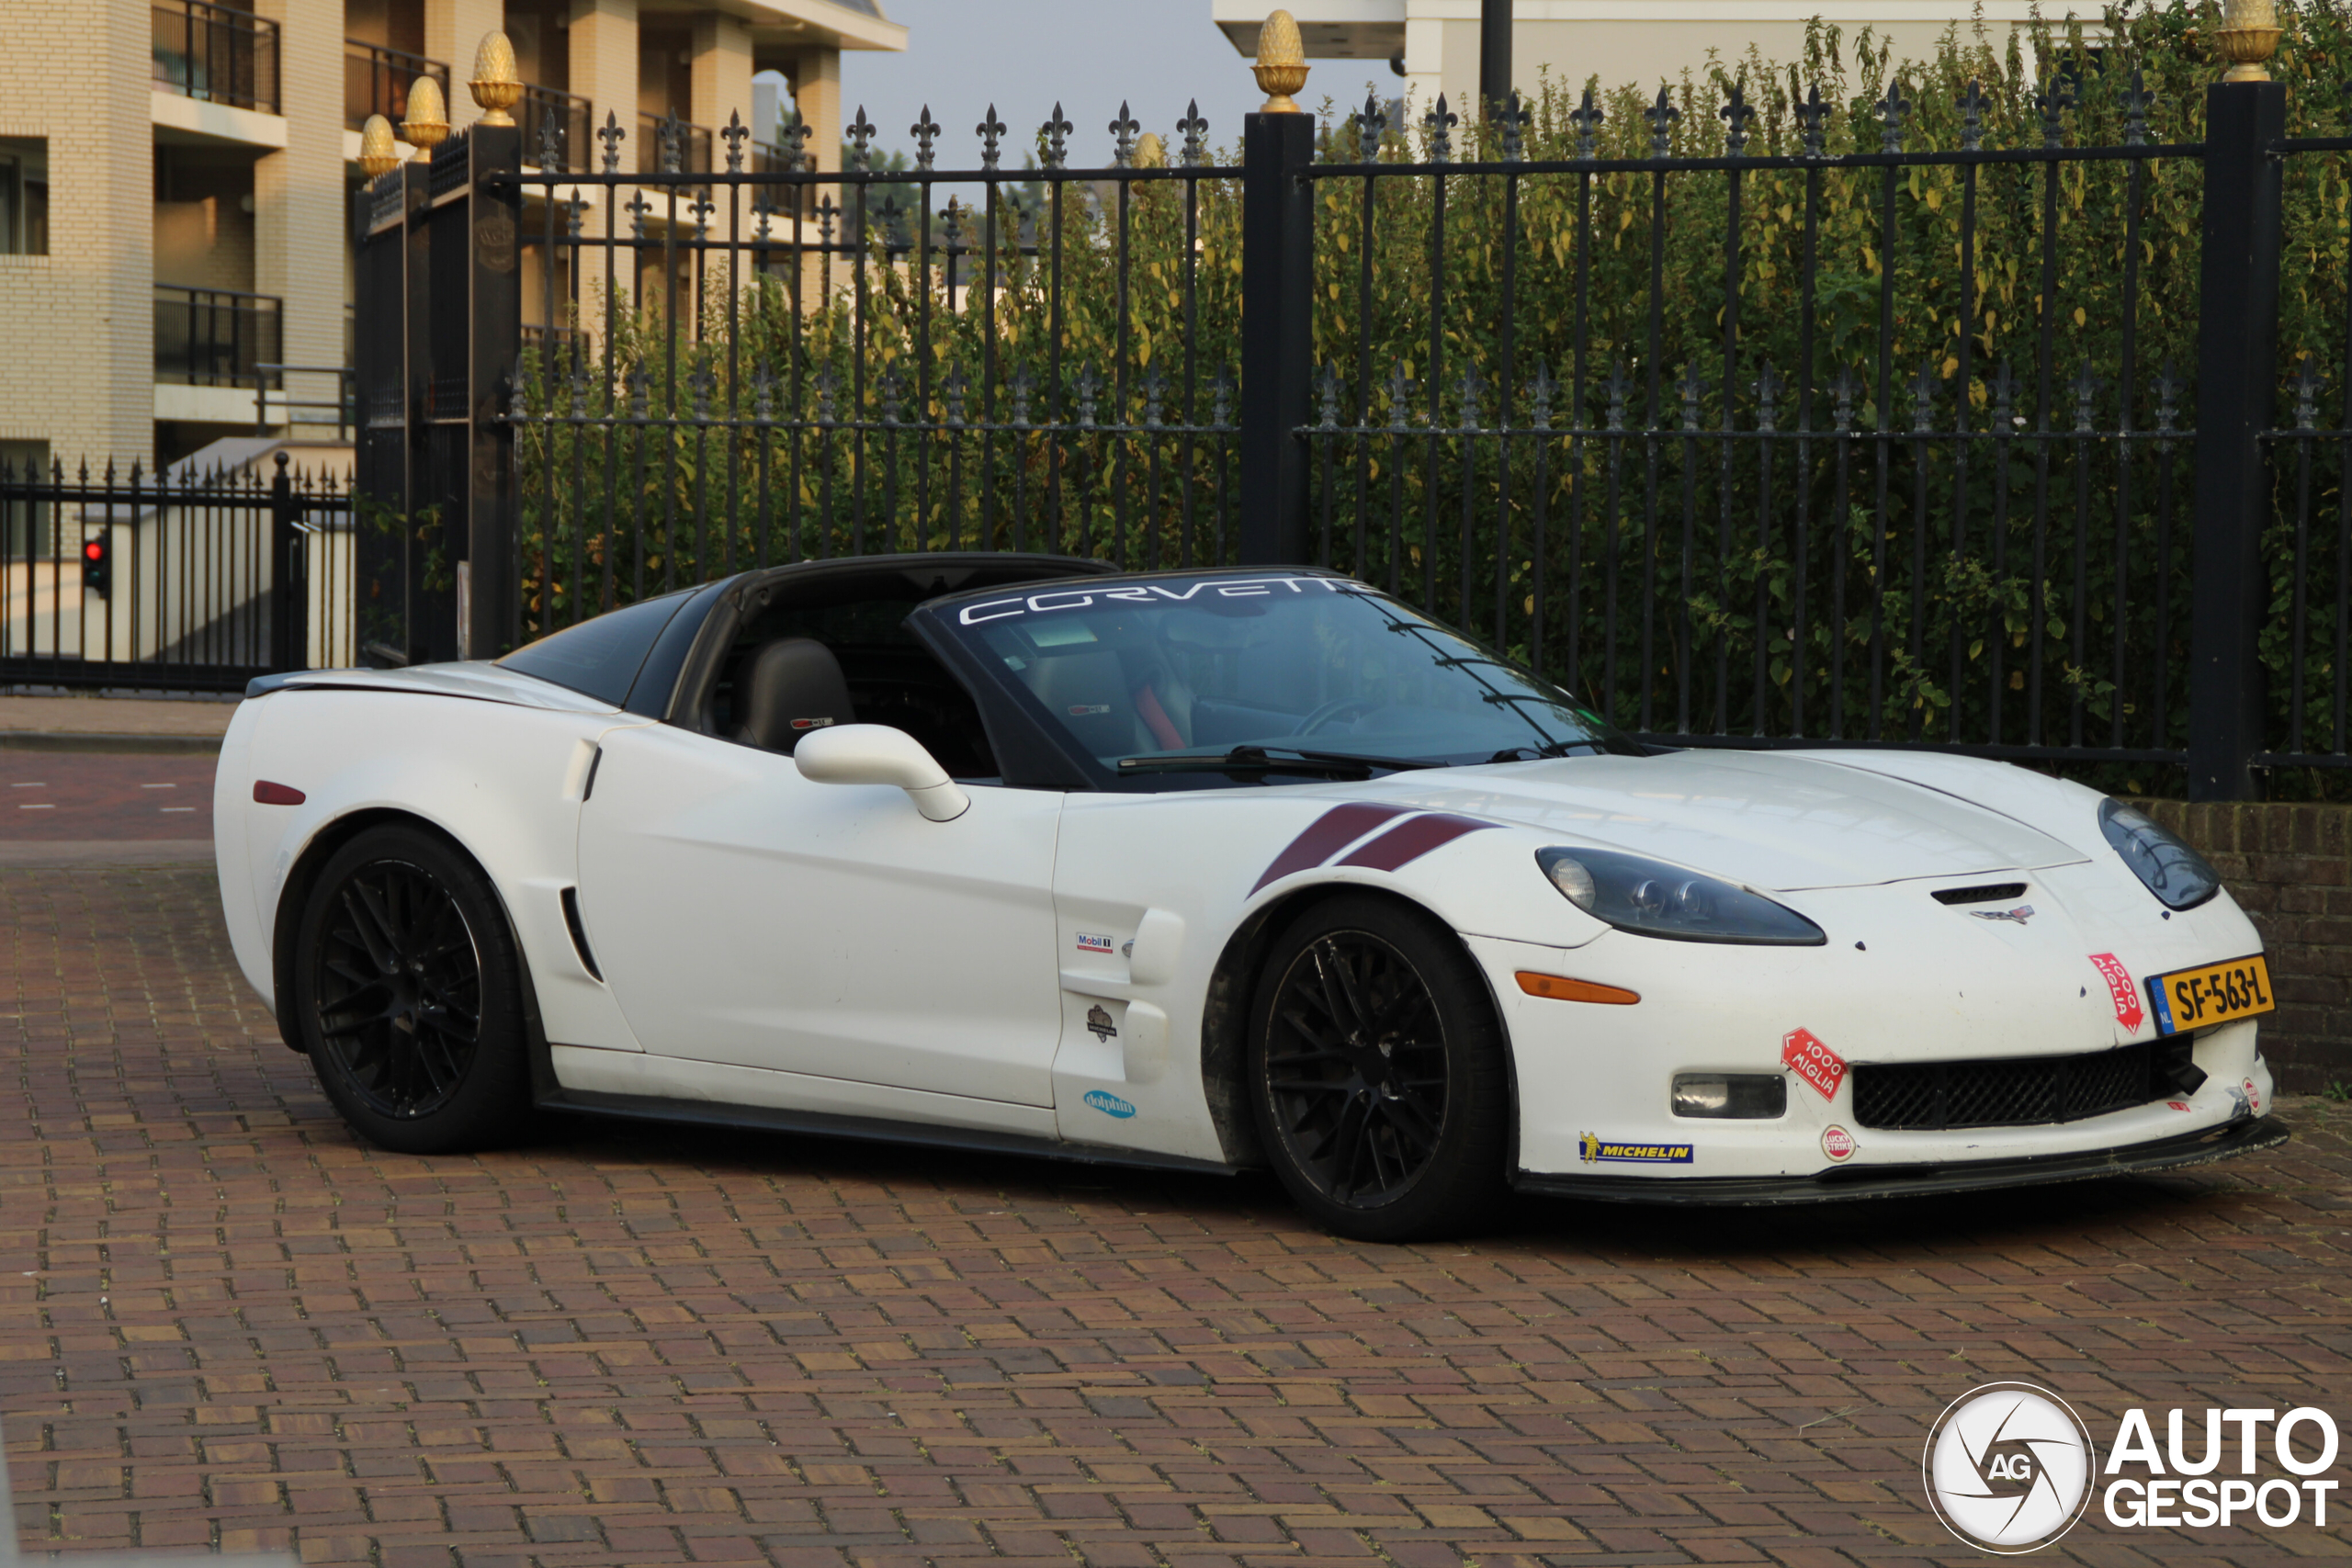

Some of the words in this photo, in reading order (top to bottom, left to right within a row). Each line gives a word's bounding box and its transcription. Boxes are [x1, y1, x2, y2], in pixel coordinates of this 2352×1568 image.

[1079, 935, 1102, 946] Mobil
[2092, 957, 2127, 1014] MIGLIA
[2109, 958, 2137, 1009] 1000
[2176, 966, 2267, 1021] SF-563-L
[2160, 1011, 2172, 1024] NL
[1806, 1040, 1841, 1076] 1000
[1792, 1053, 1835, 1094] MIGLIA
[1086, 1093, 1133, 1113] dolphin
[1826, 1134, 1850, 1143] LUCKY
[1826, 1143, 1852, 1151] STRIKE
[1601, 1145, 1689, 1157] MICHELIN
